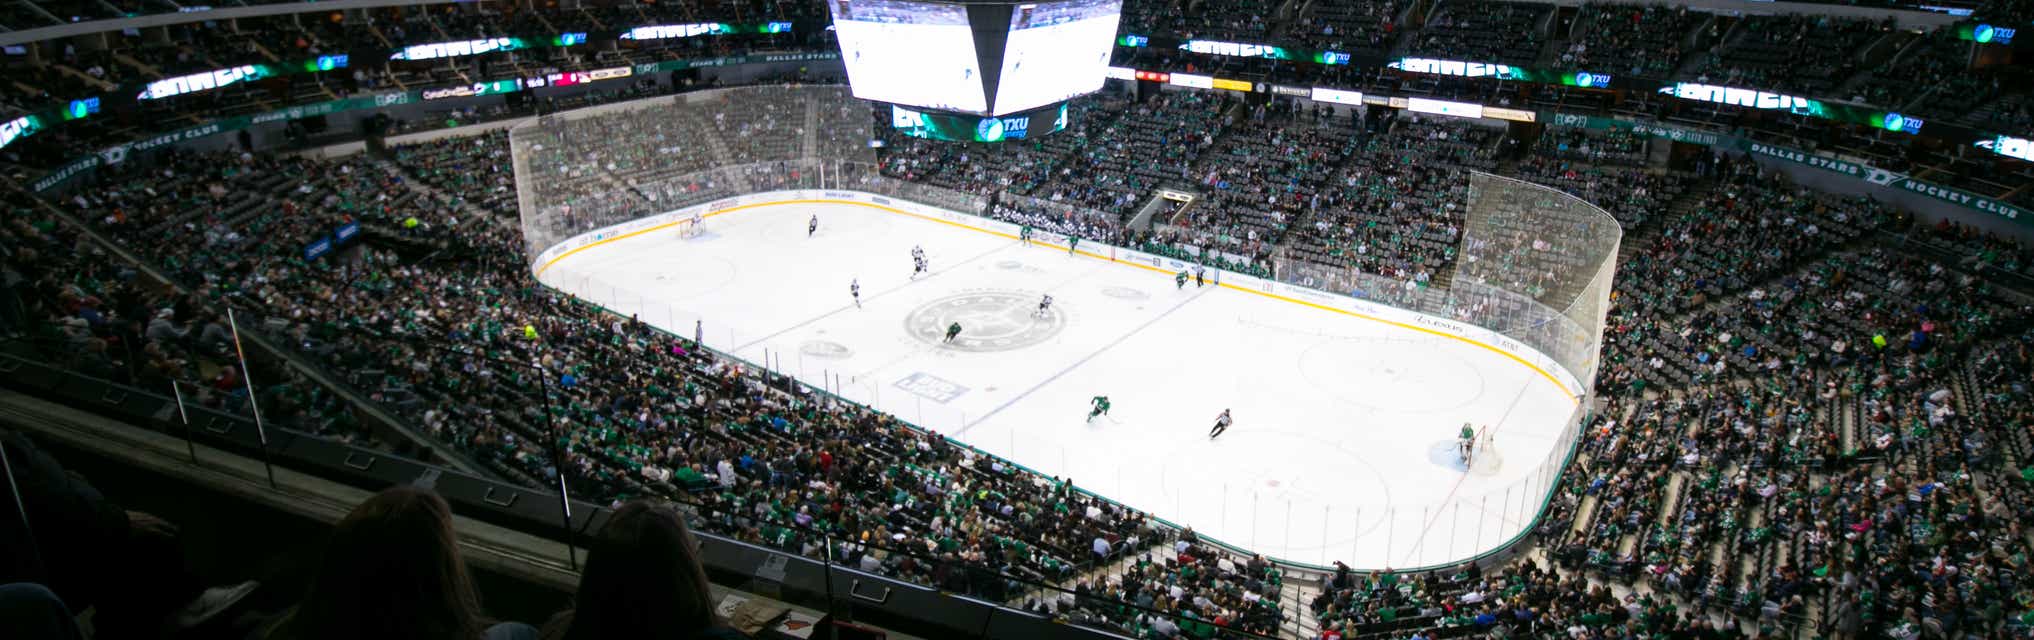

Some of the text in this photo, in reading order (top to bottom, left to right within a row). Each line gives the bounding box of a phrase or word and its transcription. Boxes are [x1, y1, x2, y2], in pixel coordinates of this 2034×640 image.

[1994, 26, 2016, 39] TXU
[1592, 74, 1610, 83] TXU
[1003, 117, 1029, 131] TXU
[1903, 116, 1924, 129] TXU
[186, 124, 220, 138] CLUB
[1752, 143, 1858, 174] DALLAS STARS
[1904, 180, 2019, 219] HOCKEY CLUB
